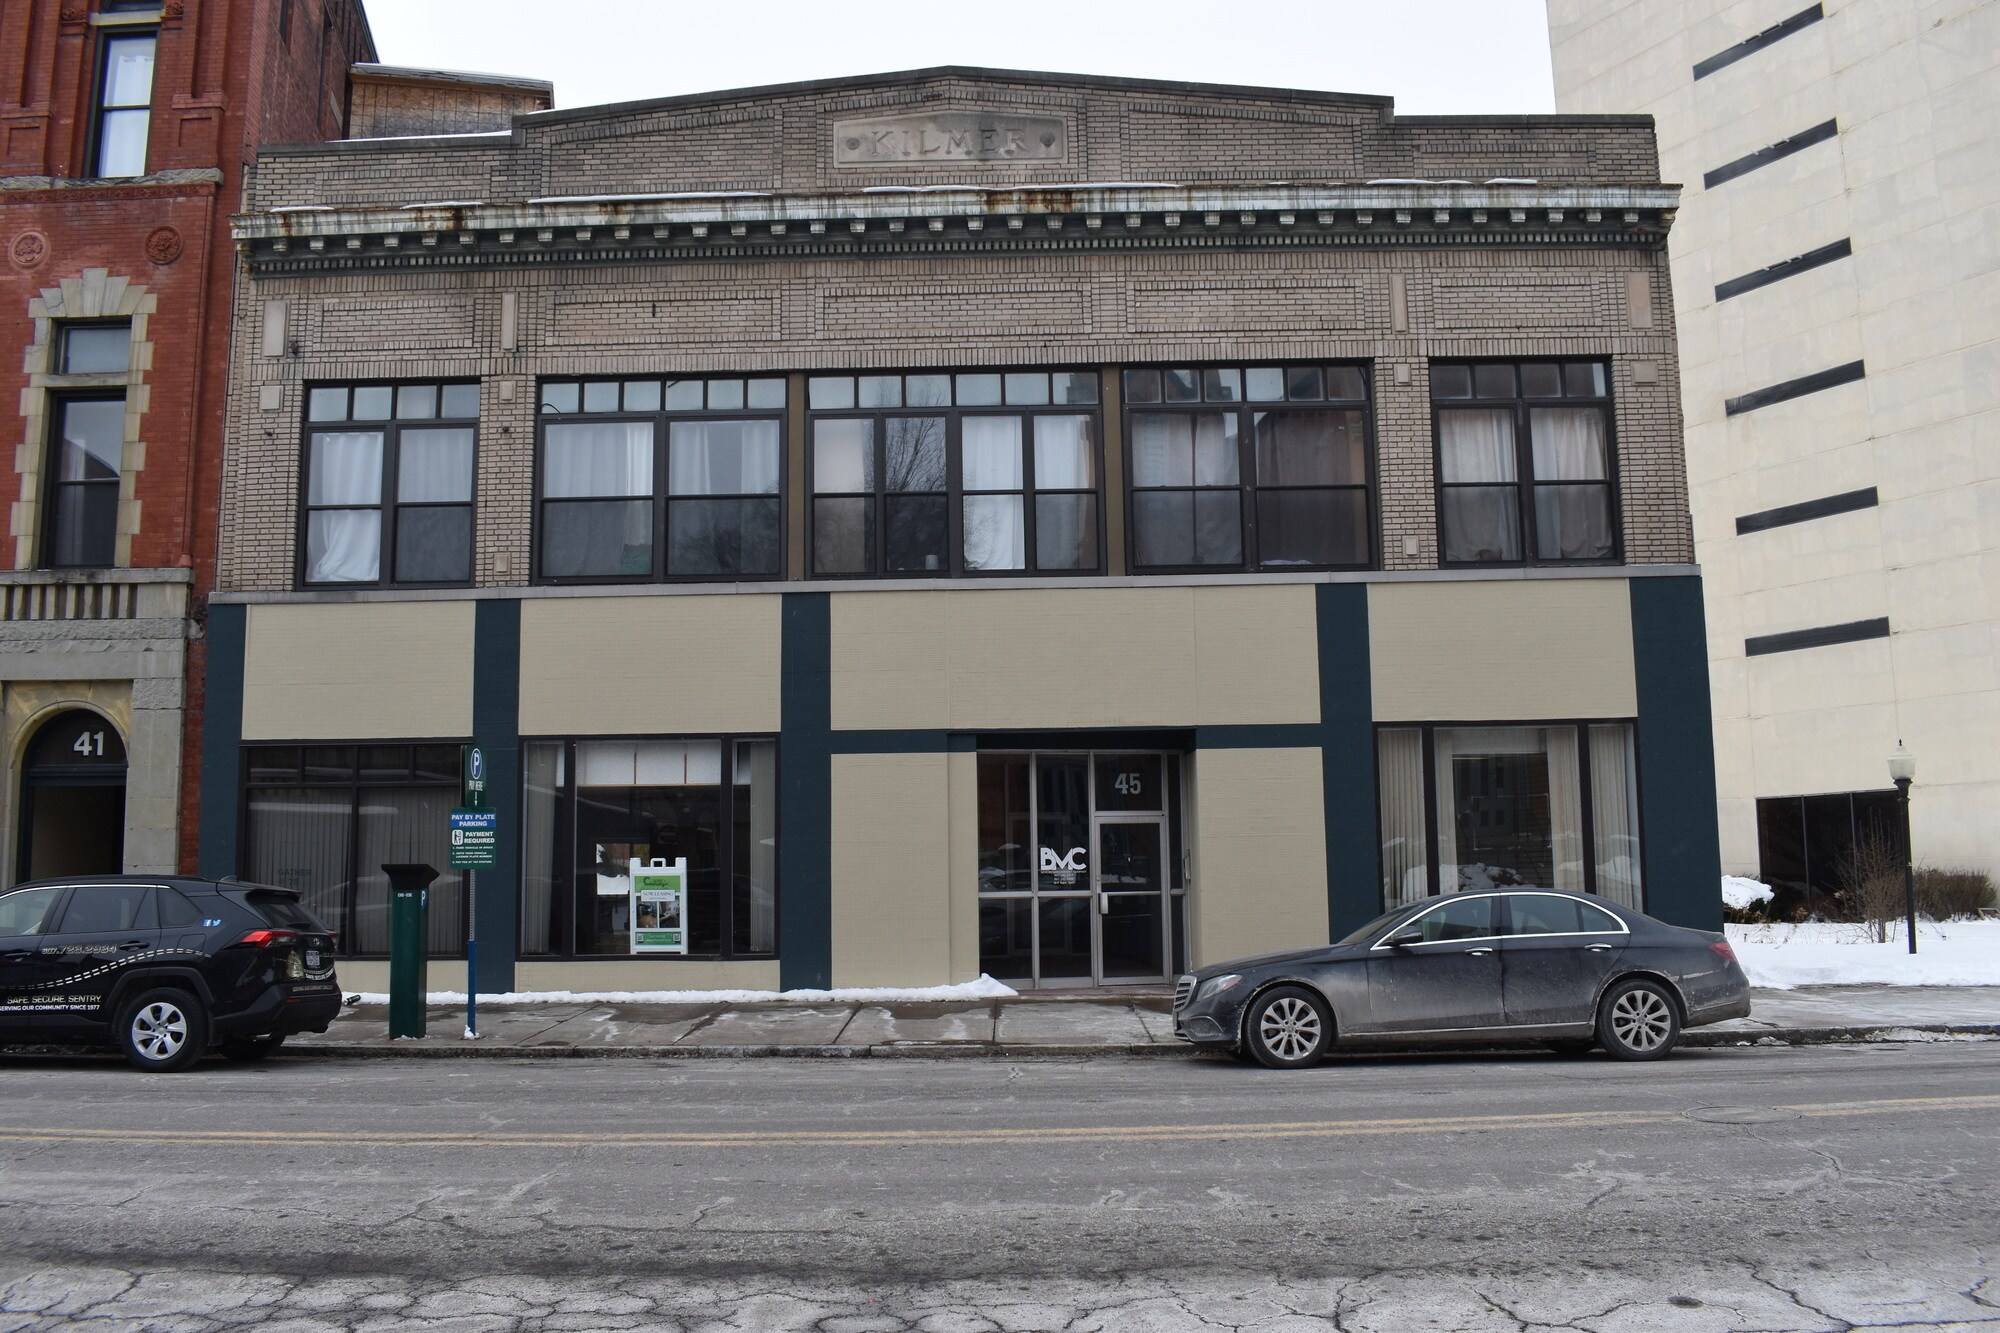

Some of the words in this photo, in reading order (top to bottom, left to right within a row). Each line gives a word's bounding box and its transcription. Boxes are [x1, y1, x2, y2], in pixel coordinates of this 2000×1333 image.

[871, 128, 1027, 156] KILMER
[73, 731, 104, 756] 41
[1114, 772, 1142, 795] 45
[1040, 847, 1087, 870] BMC
